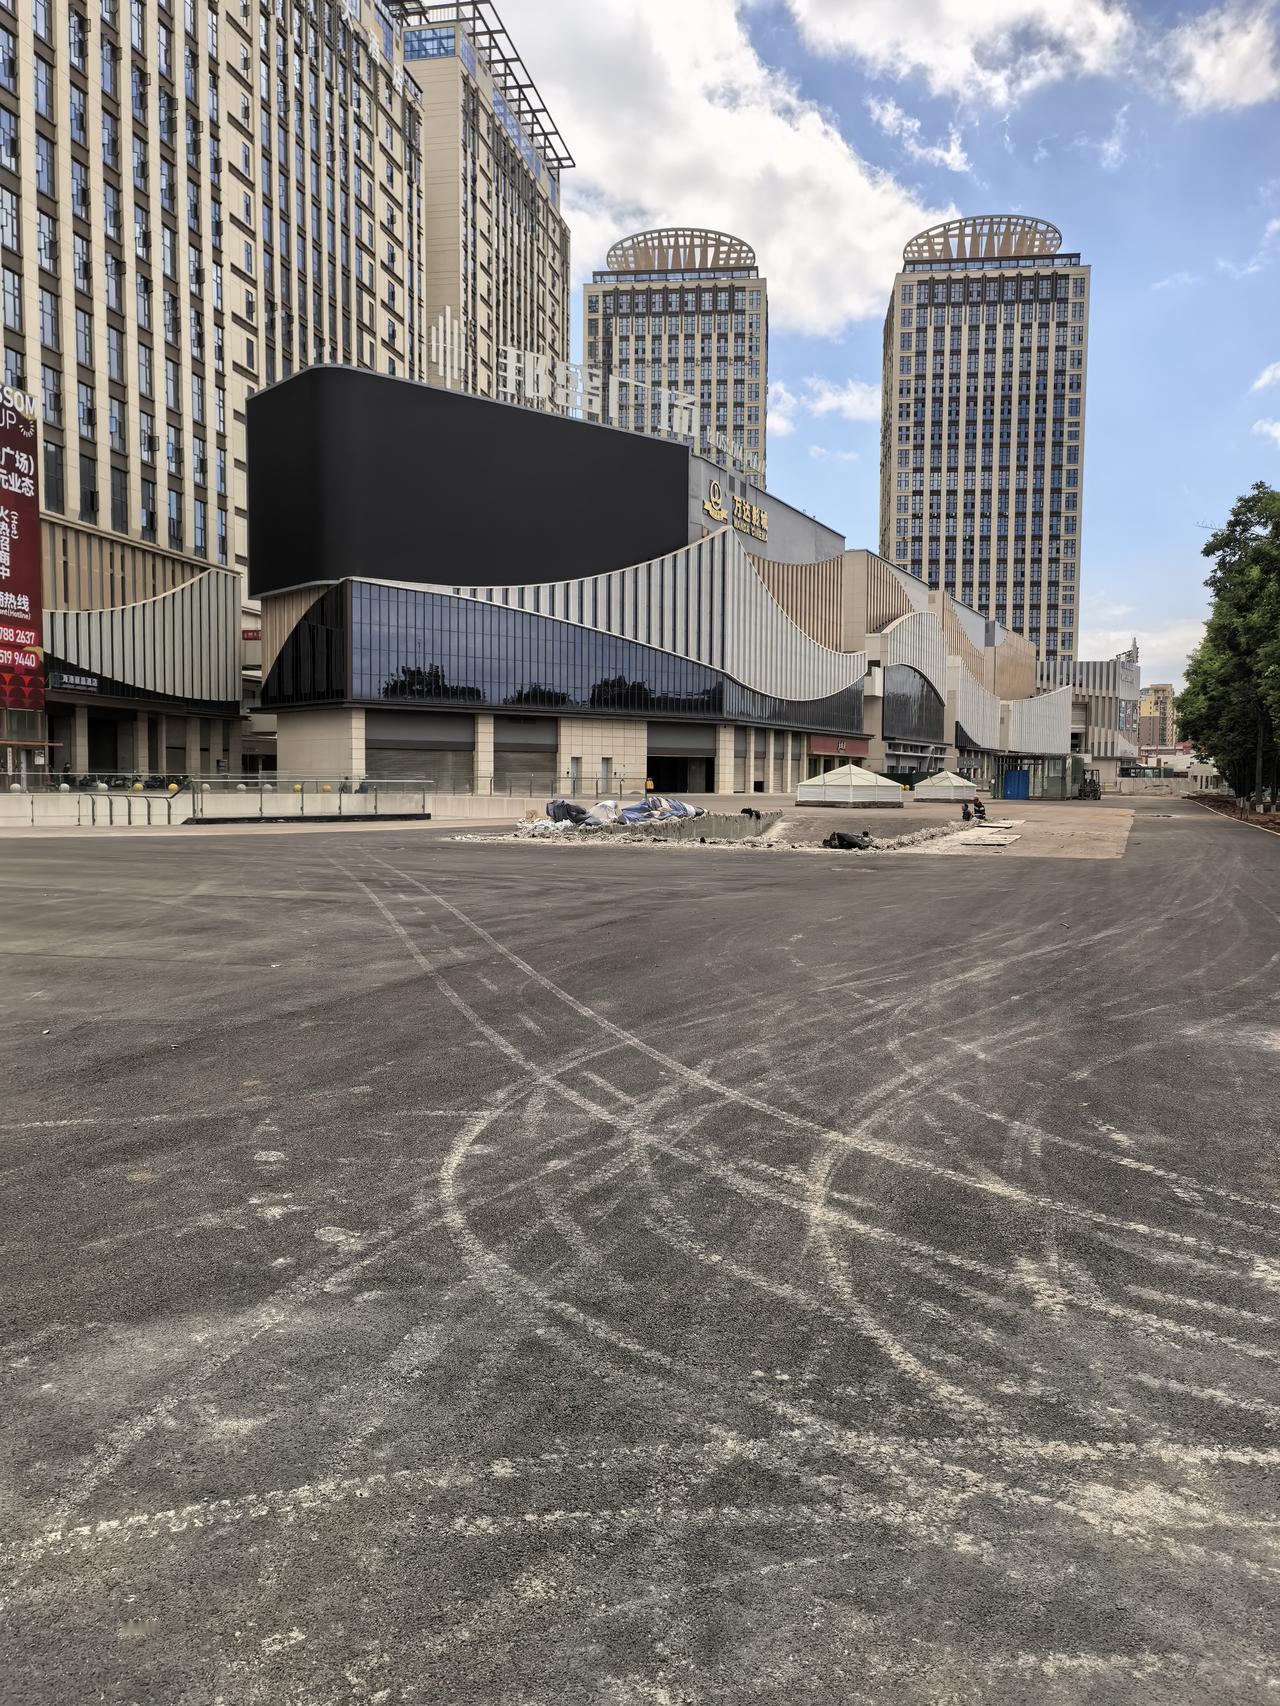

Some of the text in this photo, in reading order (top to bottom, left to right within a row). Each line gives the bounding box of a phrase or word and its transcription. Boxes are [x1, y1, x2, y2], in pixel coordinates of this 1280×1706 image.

[0, 385, 37, 417] SOM
[16, 629, 35, 645] 2637
[14, 651, 36, 668] 9440
